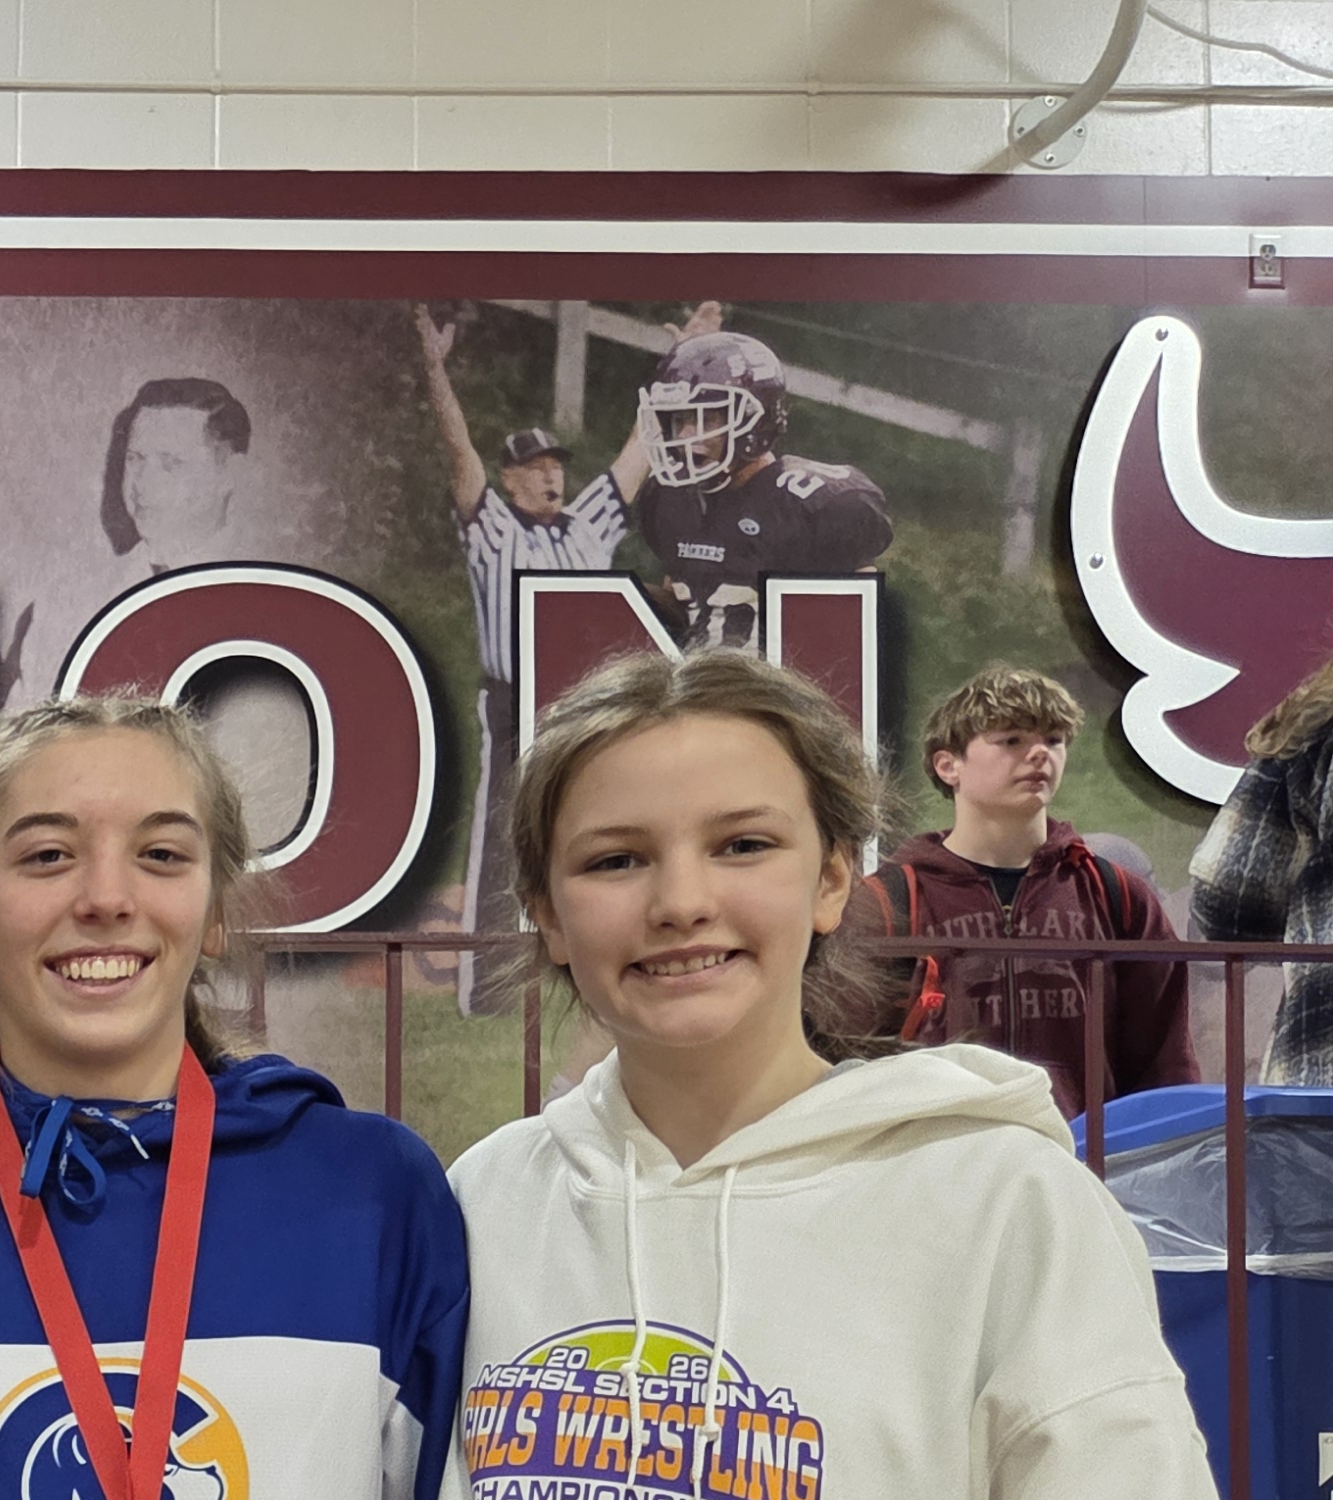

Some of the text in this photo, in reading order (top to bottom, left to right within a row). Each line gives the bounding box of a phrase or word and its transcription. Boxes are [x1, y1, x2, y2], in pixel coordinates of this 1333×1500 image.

[546, 1347, 710, 1380] 20 26
[478, 1366, 585, 1393] MSHSL
[766, 1388, 796, 1415] 4
